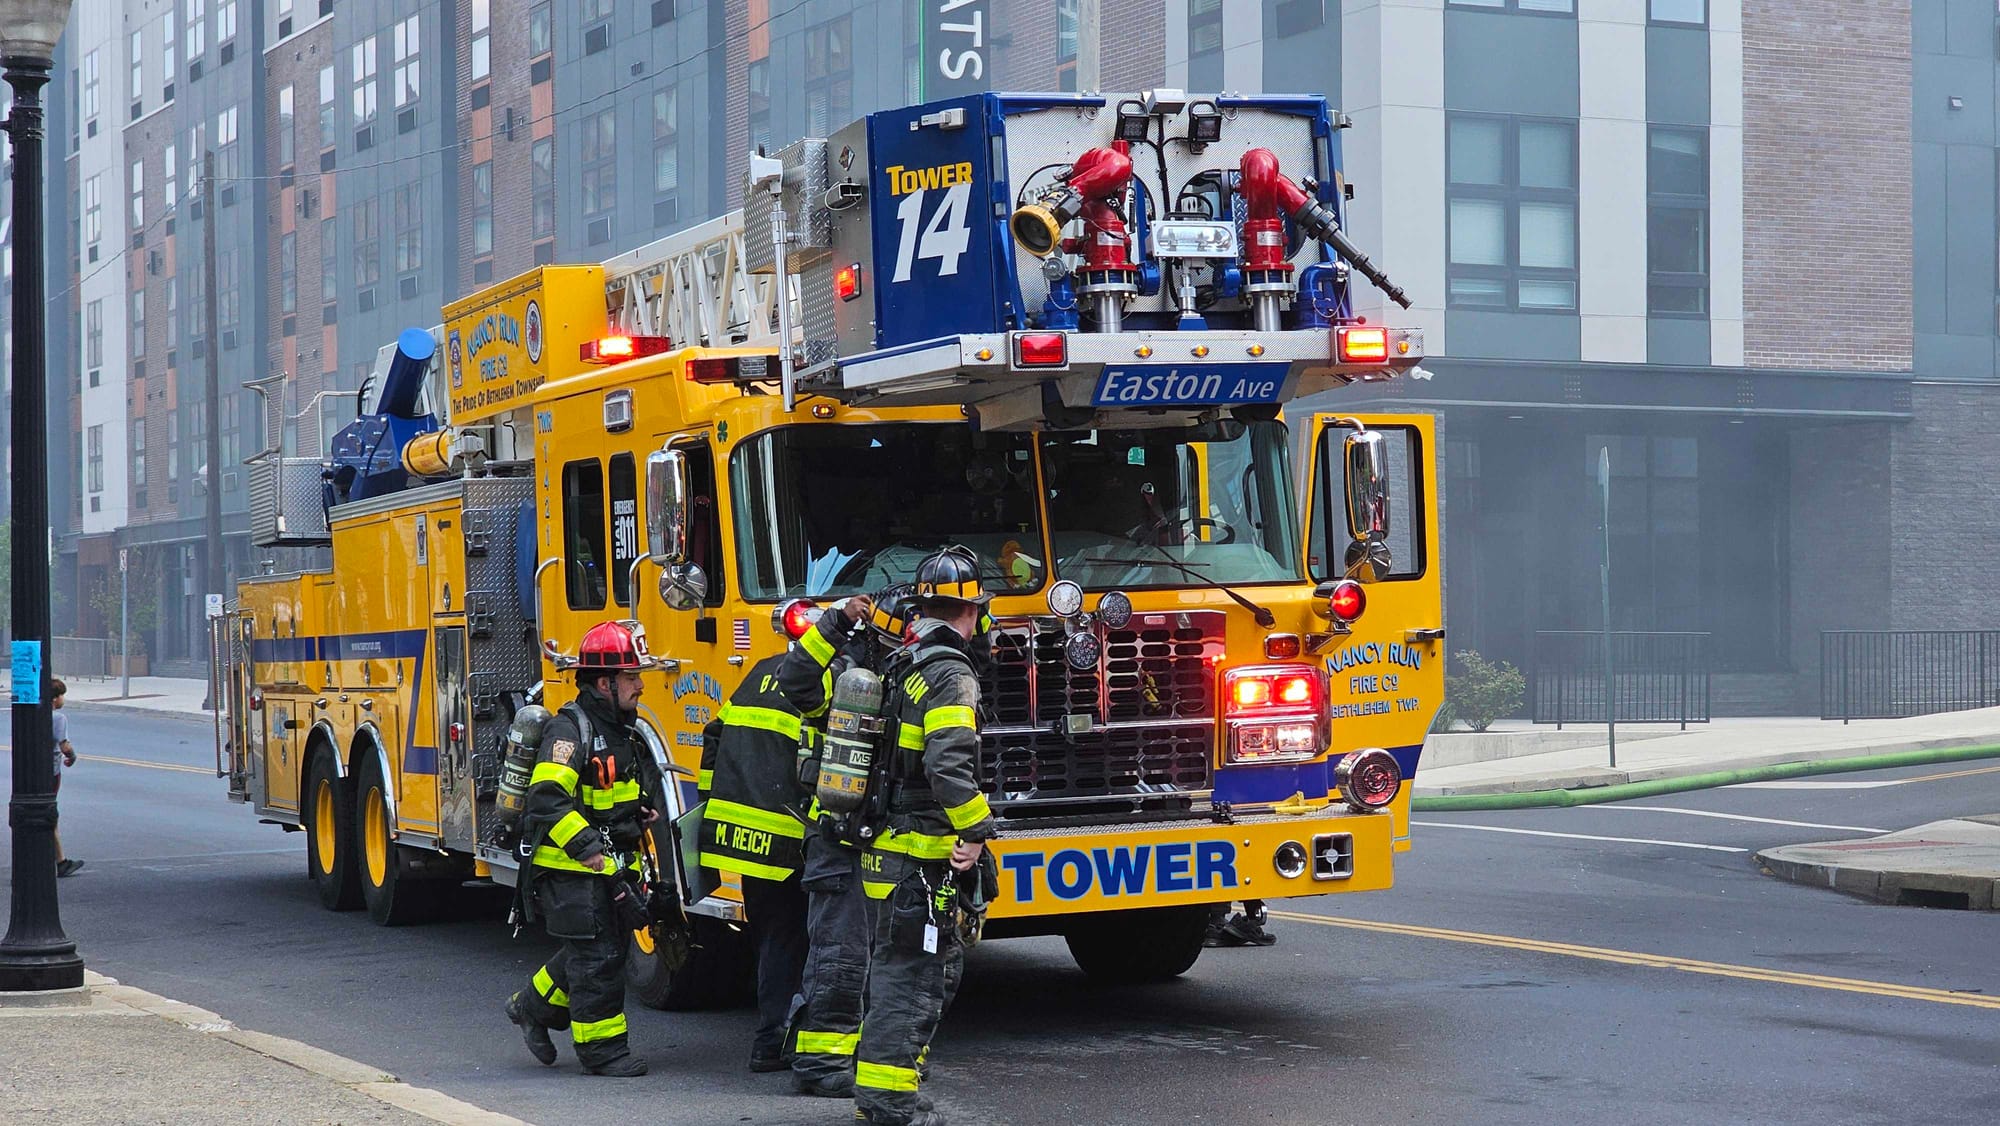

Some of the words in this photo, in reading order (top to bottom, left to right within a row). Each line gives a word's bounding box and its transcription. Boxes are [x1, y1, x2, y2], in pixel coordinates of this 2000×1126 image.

[892, 181, 971, 283] 14
[467, 313, 497, 363] NANCY
[499, 313, 519, 348] RUN
[480, 356, 496, 383] FIRE
[1100, 370, 1222, 401] Easton
[1229, 378, 1274, 398] Ave
[537, 411, 552, 433] TWR
[620, 515, 636, 560] 911
[1326, 642, 1384, 677] NANCY
[1388, 642, 1421, 671] RUN
[673, 671, 700, 704] NANCY
[703, 673, 722, 706] RUN
[1350, 675, 1378, 694] FIRE
[685, 706, 699, 723] FIRE
[1331, 701, 1391, 719] BETHLEHEM
[715, 822, 728, 846] M.
[732, 826, 772, 856] REICH
[1002, 841, 1238, 902] TOWER
